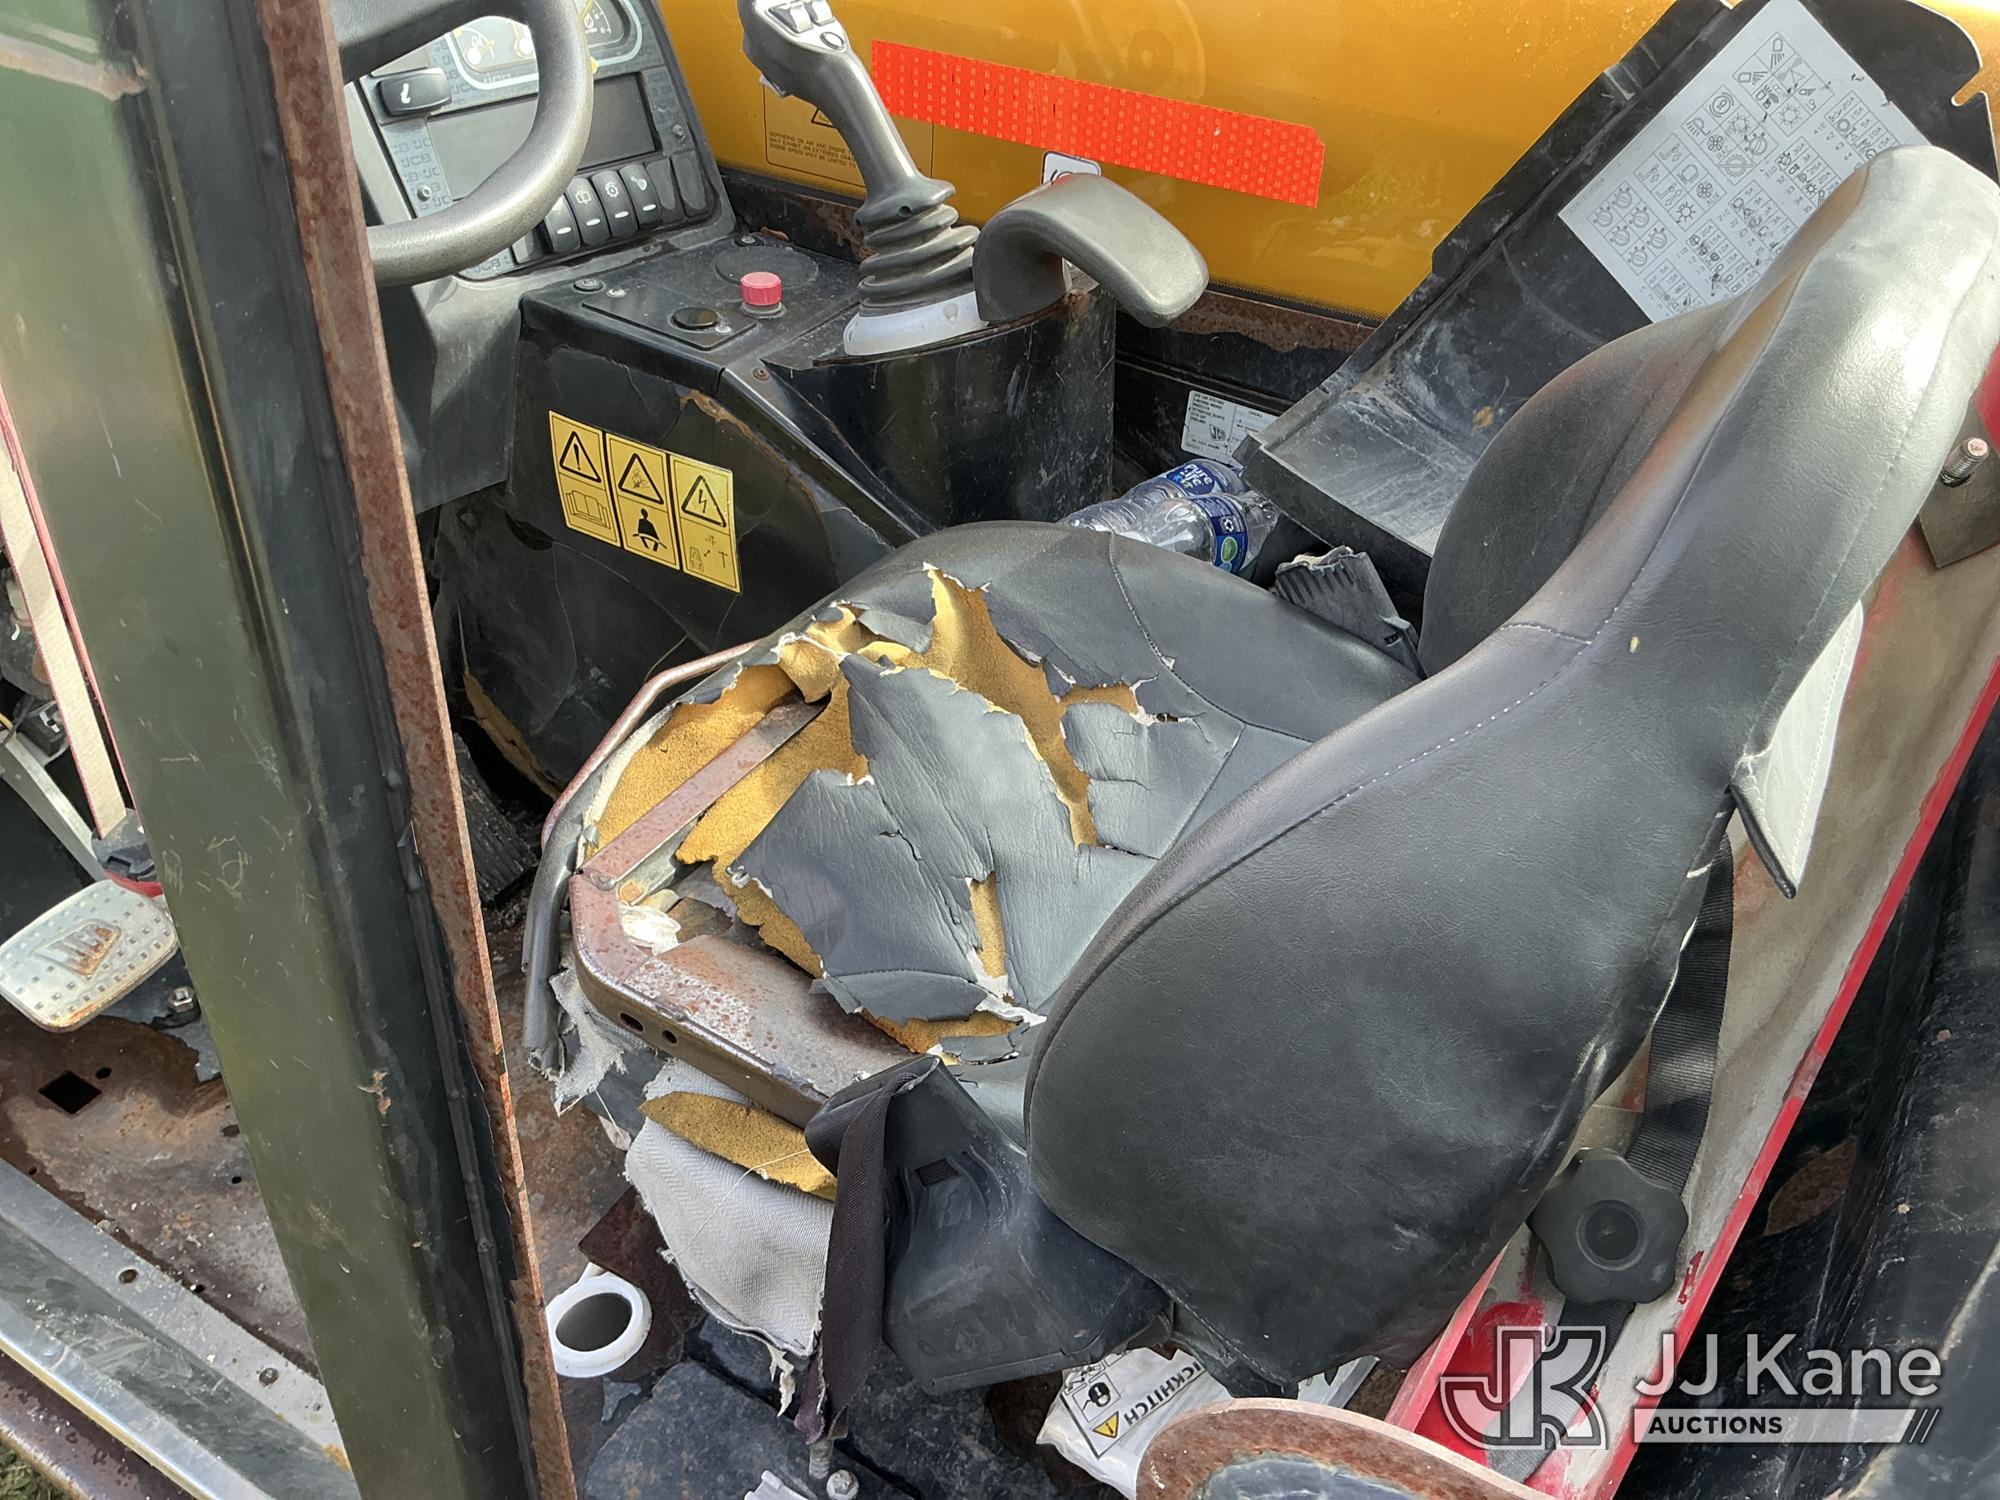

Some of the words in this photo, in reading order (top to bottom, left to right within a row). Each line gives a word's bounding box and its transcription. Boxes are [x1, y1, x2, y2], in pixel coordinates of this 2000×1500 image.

[400, 153, 432, 168] JCB
[1180, 471, 1202, 487] Life
[1184, 463, 1213, 486] Pure
